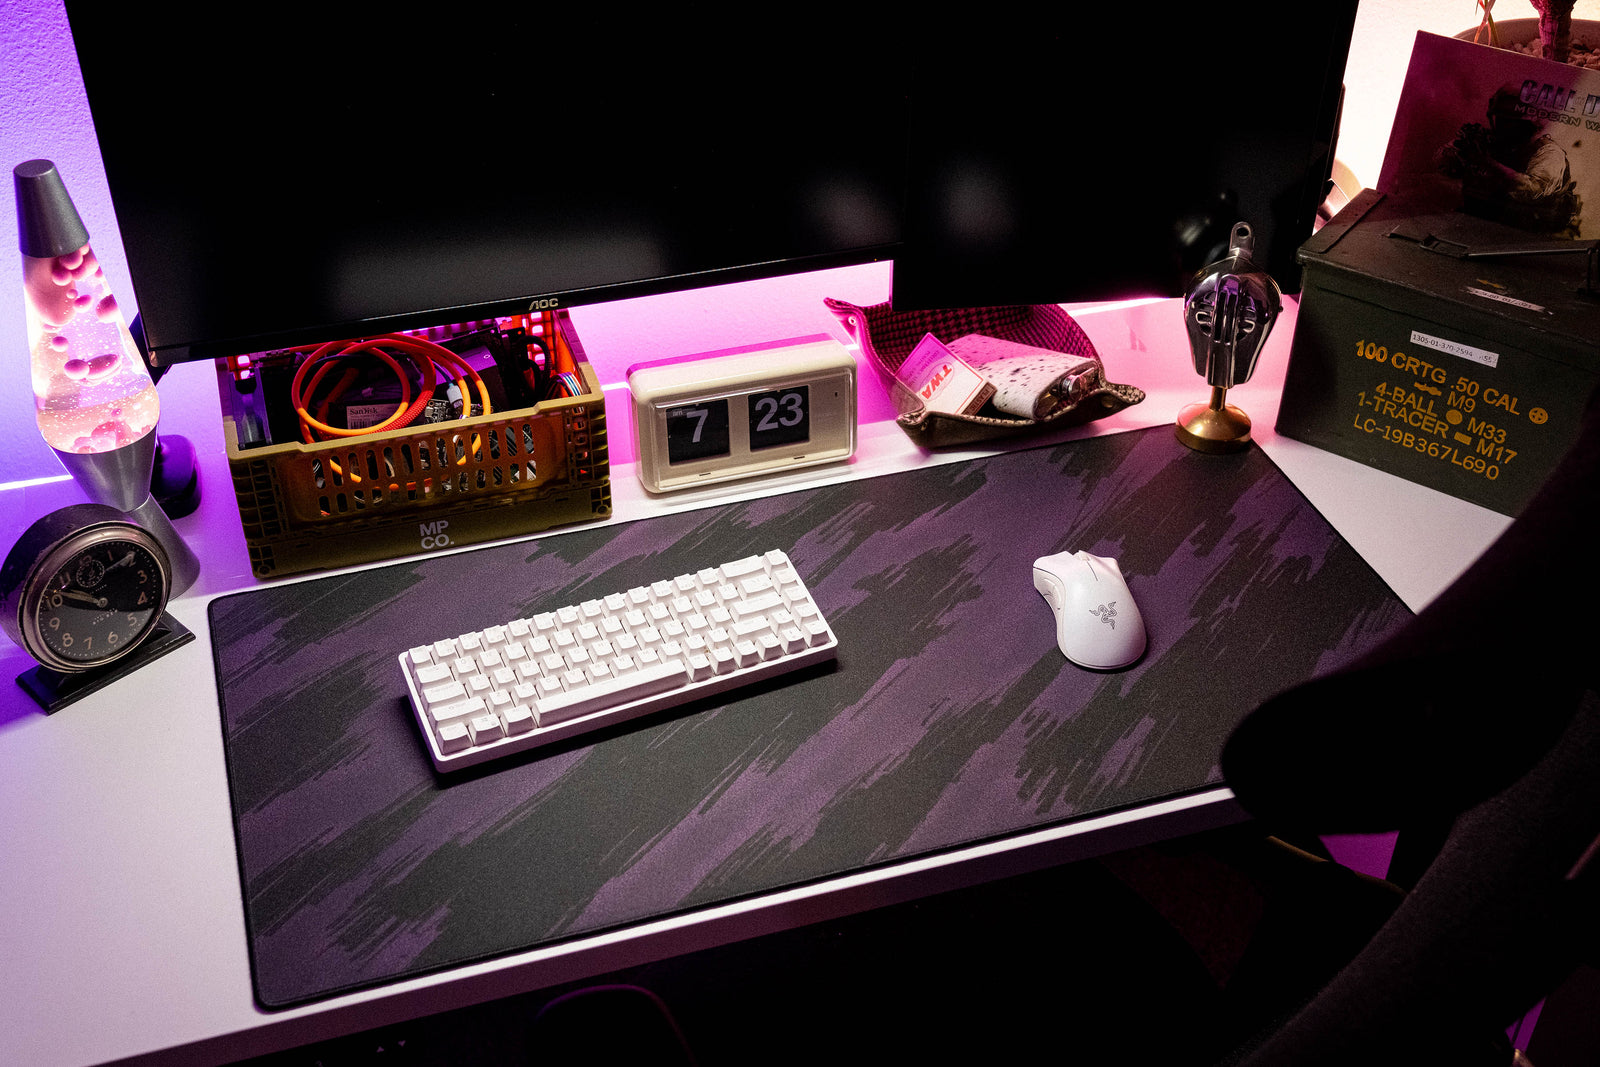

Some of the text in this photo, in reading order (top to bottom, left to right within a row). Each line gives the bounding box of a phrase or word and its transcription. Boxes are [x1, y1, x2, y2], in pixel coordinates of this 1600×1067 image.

[1520, 80, 1577, 113] CALL
[1514, 104, 1581, 127] MODERN
[528, 298, 559, 311] AOC
[921, 364, 952, 400] TWA
[1356, 339, 1521, 415] 100 CRTG .50 CAL
[1447, 391, 1476, 413] M9
[755, 392, 804, 433] 23
[1375, 382, 1507, 444] 4-BALL M33
[686, 409, 709, 443] 7
[1357, 391, 1518, 464] 1-TRACER M17
[1353, 413, 1500, 480] LC-19B367L690
[420, 520, 449, 537] MP
[421, 533, 455, 549] CO.
[137, 570, 147, 584] 3
[137, 591, 148, 605] 4
[49, 617, 60, 631] 9
[127, 613, 137, 627] 5
[62, 633, 73, 647] 8
[83, 636, 93, 650] 7
[107, 631, 118, 644] 6
